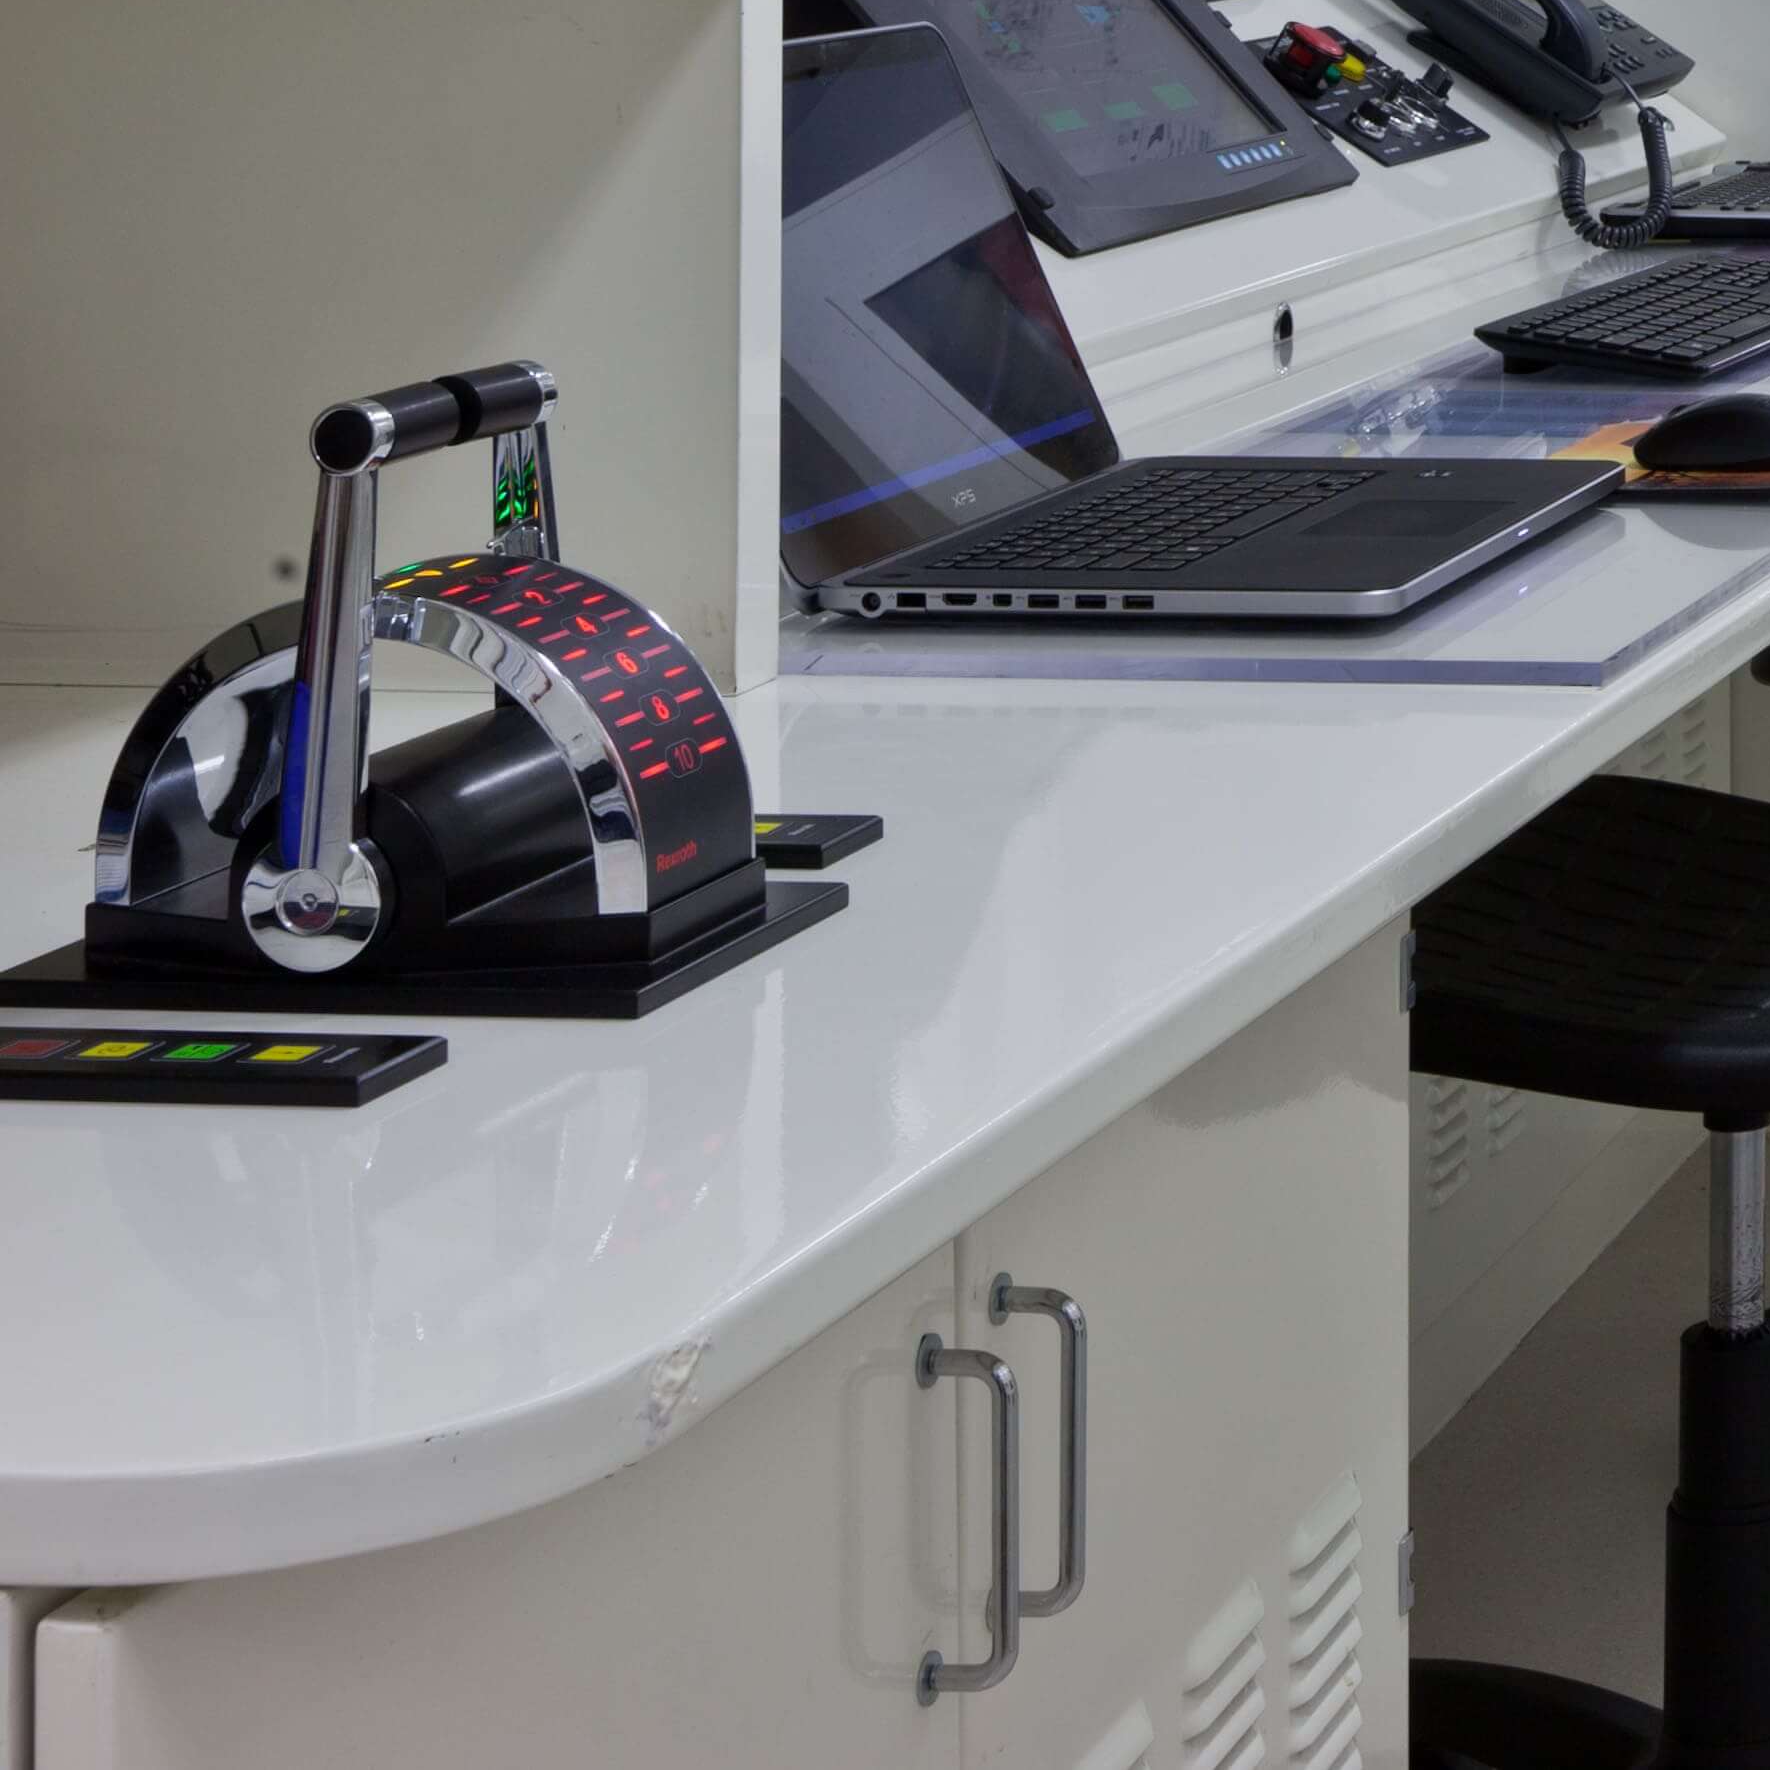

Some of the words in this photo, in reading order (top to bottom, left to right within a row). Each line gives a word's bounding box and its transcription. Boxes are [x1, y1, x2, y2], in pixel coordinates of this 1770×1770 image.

[952, 488, 977, 508] XPS
[524, 591, 552, 607] 2
[575, 616, 598, 635] 4
[616, 651, 639, 675] 6
[651, 696, 671, 720] 8
[673, 744, 694, 772] 10
[656, 840, 698, 873] Rexroth
